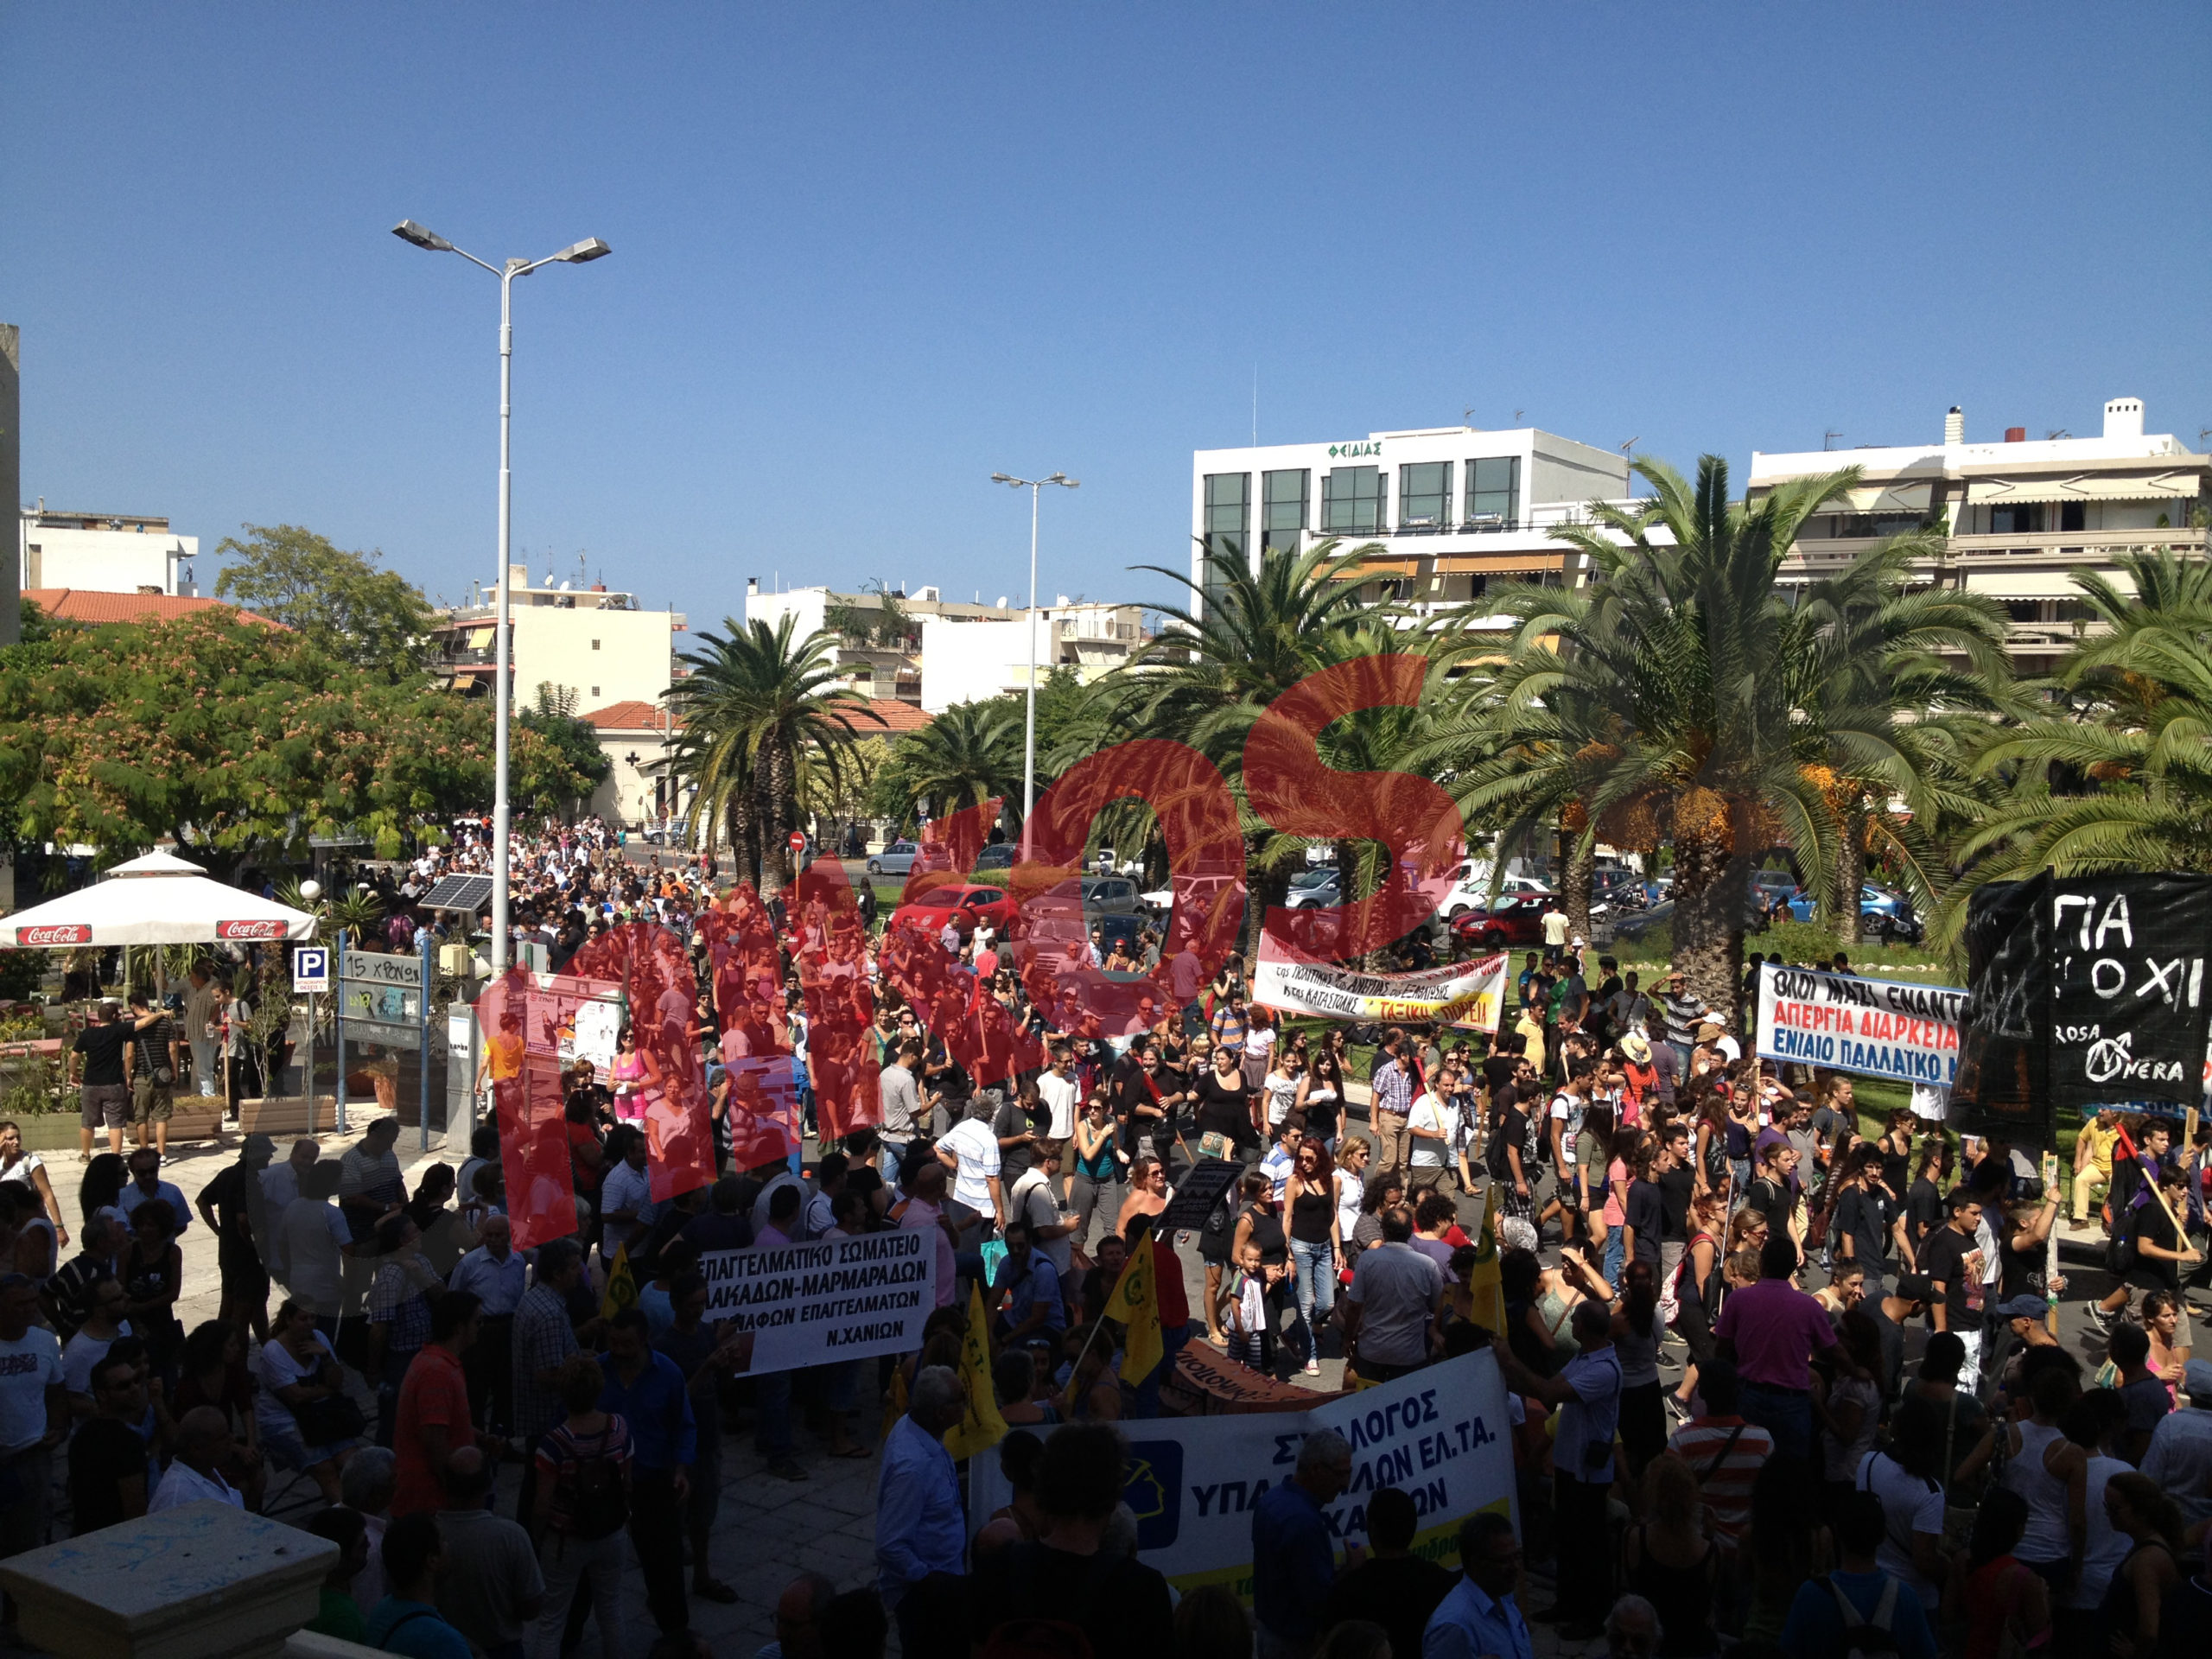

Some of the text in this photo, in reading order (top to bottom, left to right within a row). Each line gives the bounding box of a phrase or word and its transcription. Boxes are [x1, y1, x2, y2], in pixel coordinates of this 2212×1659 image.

[302, 953, 322, 976] P
[346, 955, 366, 978] 15
[1773, 970, 1817, 1000] ΟΛΟΙ
[1440, 1000, 1487, 1025] ΠΟΡΕΙΑ
[1773, 1001, 1853, 1034] ΑΠΕΡΓΙΑ
[1773, 1027, 1834, 1062] ΕΝΙΑΙΟ
[2122, 1060, 2183, 1082] NERA
[838, 1234, 920, 1264] ΣΩΜΑΤΕΙΟ
[800, 1291, 920, 1323] ΕΠΑΓΓΕΛΜΑΤΩΝ
[826, 1320, 905, 1347] Ν.ΧΑΝΙΩΝ
[1419, 1416, 1496, 1470] ΕΛ.ΤΑ.
